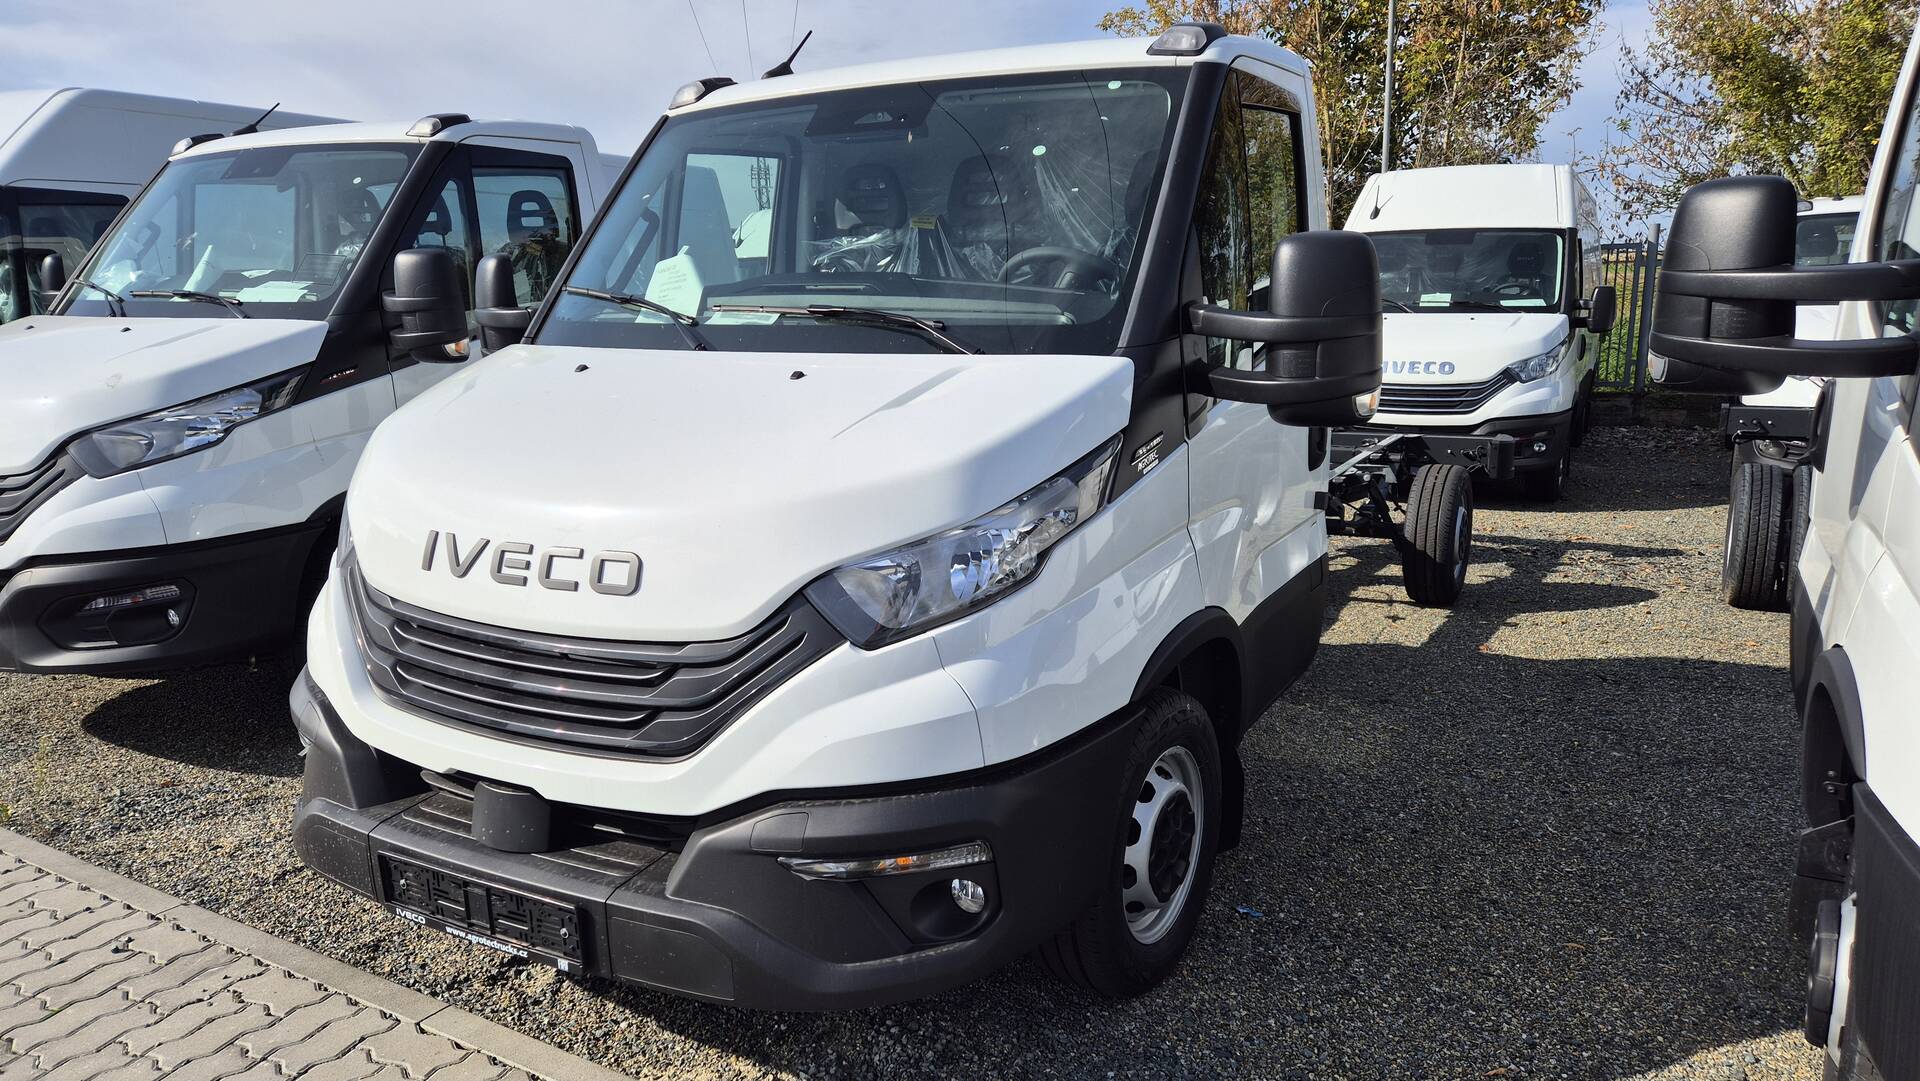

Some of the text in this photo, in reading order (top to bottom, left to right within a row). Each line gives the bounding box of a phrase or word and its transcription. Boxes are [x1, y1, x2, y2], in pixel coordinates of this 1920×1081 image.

[421, 529, 643, 597] IVECO
[395, 907, 426, 924] IVECO
[445, 926, 529, 959] www.agrotectrucks.cz
